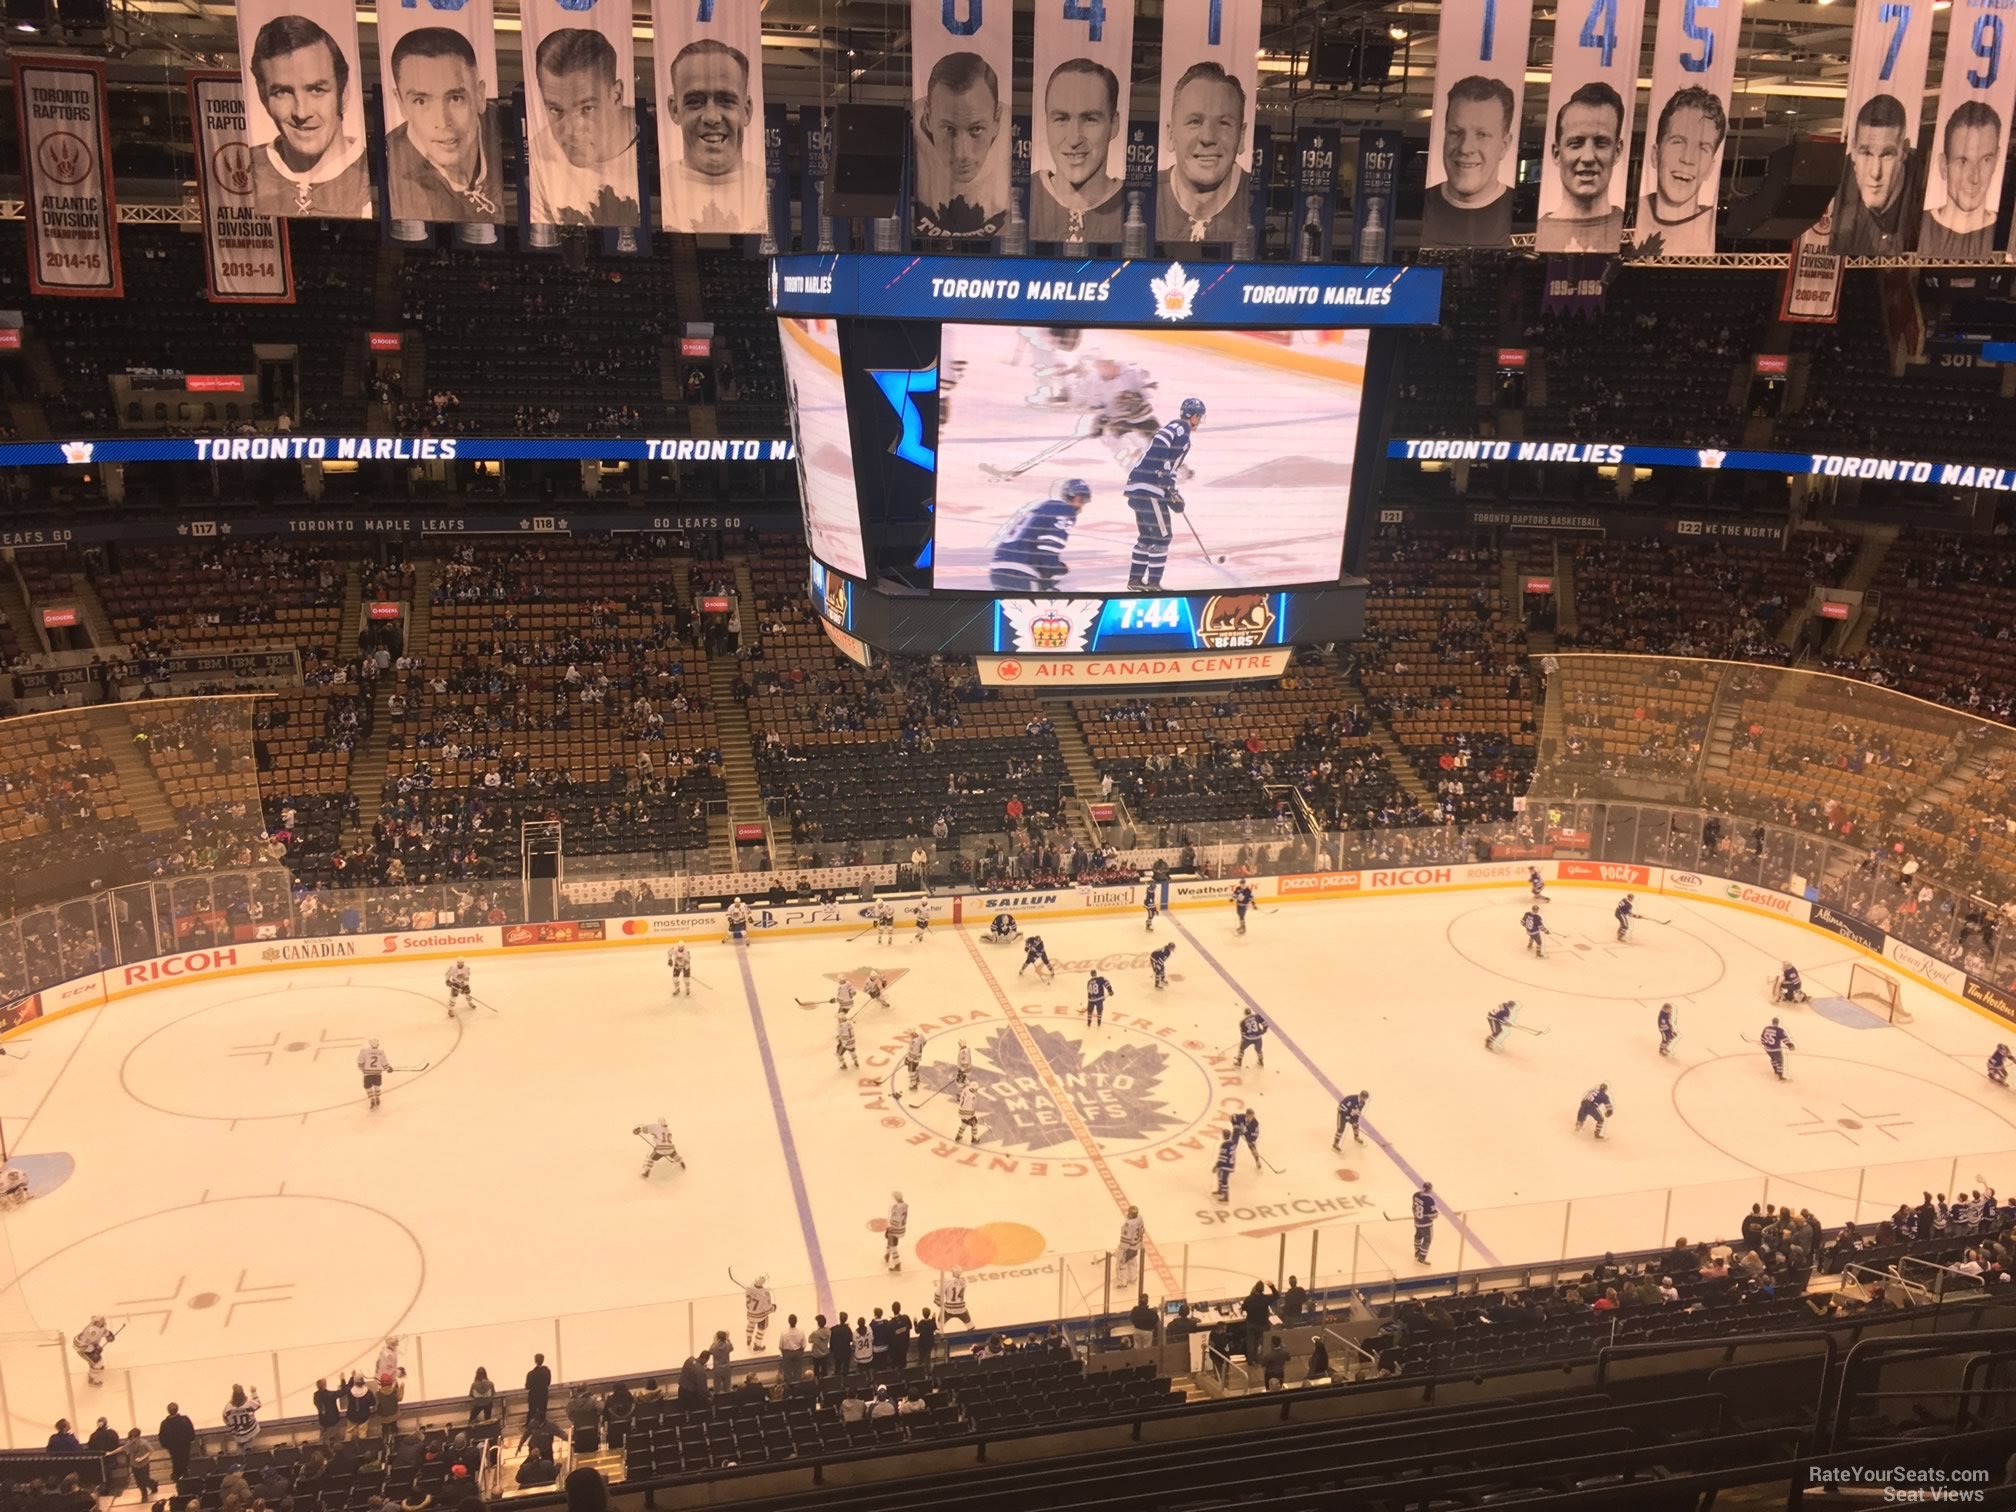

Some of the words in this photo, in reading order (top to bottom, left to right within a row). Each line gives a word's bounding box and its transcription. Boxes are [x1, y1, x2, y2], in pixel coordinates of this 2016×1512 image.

[1579, 0, 1618, 67] 4
[1680, 0, 1714, 72] 5
[1879, 4, 1912, 80] 7
[1966, 14, 2003, 89] 9
[32, 87, 90, 105] TORONTO
[33, 104, 91, 122] RAPTORS
[205, 98, 245, 115] TORON
[207, 115, 247, 131] RAPTO
[807, 131, 833, 150] 194
[1302, 150, 1333, 169] 1964
[1365, 152, 1394, 170] 1967
[42, 195, 98, 212] ATLANTIC
[42, 211, 99, 228] DIVISION
[217, 221, 273, 238] DIVISION
[46, 252, 100, 269] 2014-15
[1800, 256, 1836, 270] DIVISION
[222, 262, 275, 278] 2013-14
[931, 278, 1019, 299] TORONTO
[1026, 279, 1110, 302] MARLIES
[1242, 284, 1318, 305] TORONTO
[1323, 286, 1392, 305] MARLIES
[1940, 353, 1973, 367] 301
[193, 437, 326, 461] TORONTO
[337, 437, 457, 461] MARLIES
[645, 438, 760, 461] TORONTO
[1405, 439, 1511, 460] TORONTO
[1517, 441, 1626, 464] MARLIES
[1810, 453, 1933, 484] TORONTO
[289, 520, 354, 532] TORONTO
[364, 519, 411, 531] MAPLE
[421, 519, 466, 531] LEAFS
[534, 518, 553, 530] 118
[653, 517, 671, 529] GO
[677, 517, 722, 529] LEAFS
[725, 517, 741, 528] GO
[1383, 512, 1401, 522] 121
[1473, 512, 1511, 525] TORONTO
[1512, 514, 1549, 526] RAPTORS
[1551, 515, 1600, 528] BASKETBALL
[3, 531, 50, 545] EAFS
[52, 529, 73, 543] GO
[193, 523, 214, 535] 117
[1679, 522, 1702, 535] 122
[1704, 524, 1718, 536] WE
[1721, 525, 1741, 537] THE
[1744, 526, 1781, 539] NORTH
[1120, 598, 1180, 629] 7:44
[1035, 661, 1076, 677] AIR
[1085, 657, 1187, 676] CANADA
[1191, 653, 1273, 673] CENTRE
[1371, 867, 1452, 888] RICOH
[1467, 867, 1511, 879] ROGERS
[1177, 883, 1260, 896] WeatherTh
[1281, 876, 1319, 893] pizza
[1320, 874, 1359, 891] pizza
[985, 895, 1057, 909] SAILUN
[1741, 887, 1792, 912] Castrol
[653, 916, 717, 930] masterpass
[403, 932, 485, 950] Scotiabank
[282, 941, 356, 961] CANADIAN
[124, 948, 238, 986] RICOH
[1892, 943, 1923, 972] Crown
[1920, 957, 1953, 985] Royal
[61, 983, 97, 1000] CCM
[1966, 982, 1983, 999] Tim
[1983, 989, 2016, 1017] Hortons
[1020, 1003, 1177, 1038] CETRE
[1195, 1194, 1376, 1226] SPORTCHEK
[950, 1286, 966, 1302] 14
[857, 1338, 870, 1351] 34
